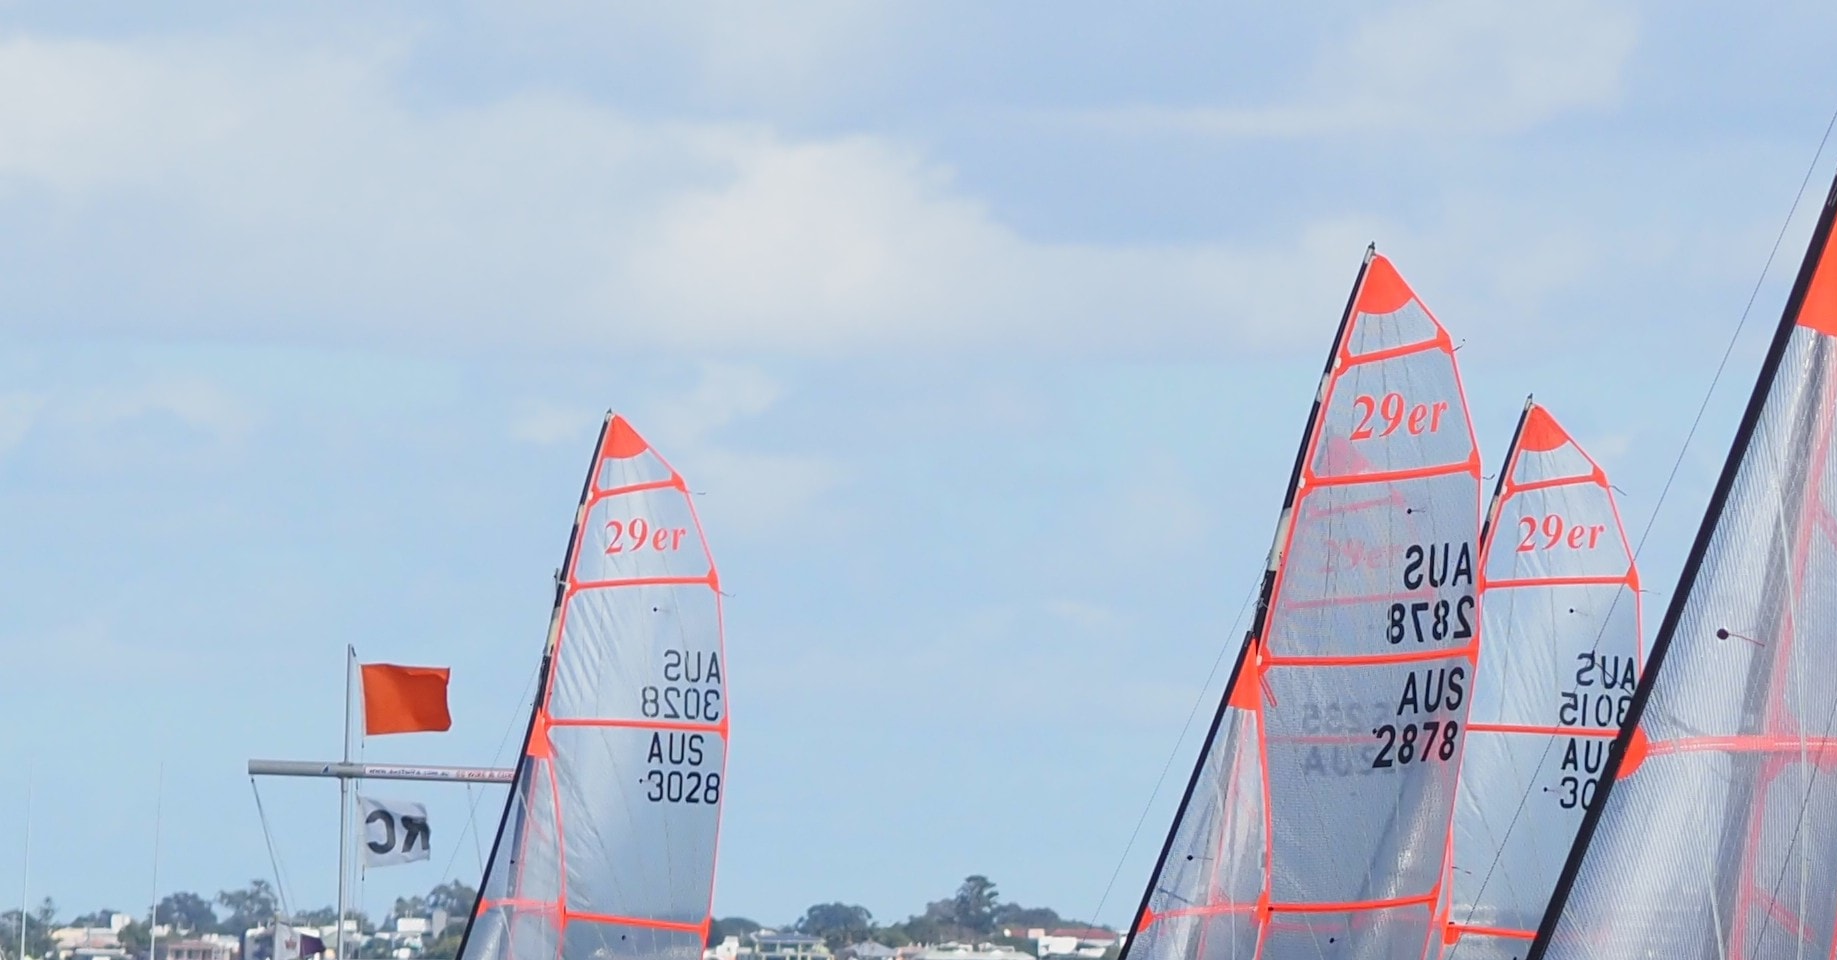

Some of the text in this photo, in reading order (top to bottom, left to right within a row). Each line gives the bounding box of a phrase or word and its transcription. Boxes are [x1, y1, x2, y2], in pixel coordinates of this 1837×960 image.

[1350, 392, 1449, 441] 29er
[604, 517, 688, 556] 29er
[1516, 514, 1605, 553] 29er
[1397, 666, 1465, 715] AUS
[647, 732, 704, 766] AUS
[1372, 720, 1458, 768] 2878
[647, 771, 721, 804] 3028
[1560, 777, 1599, 810] 30
